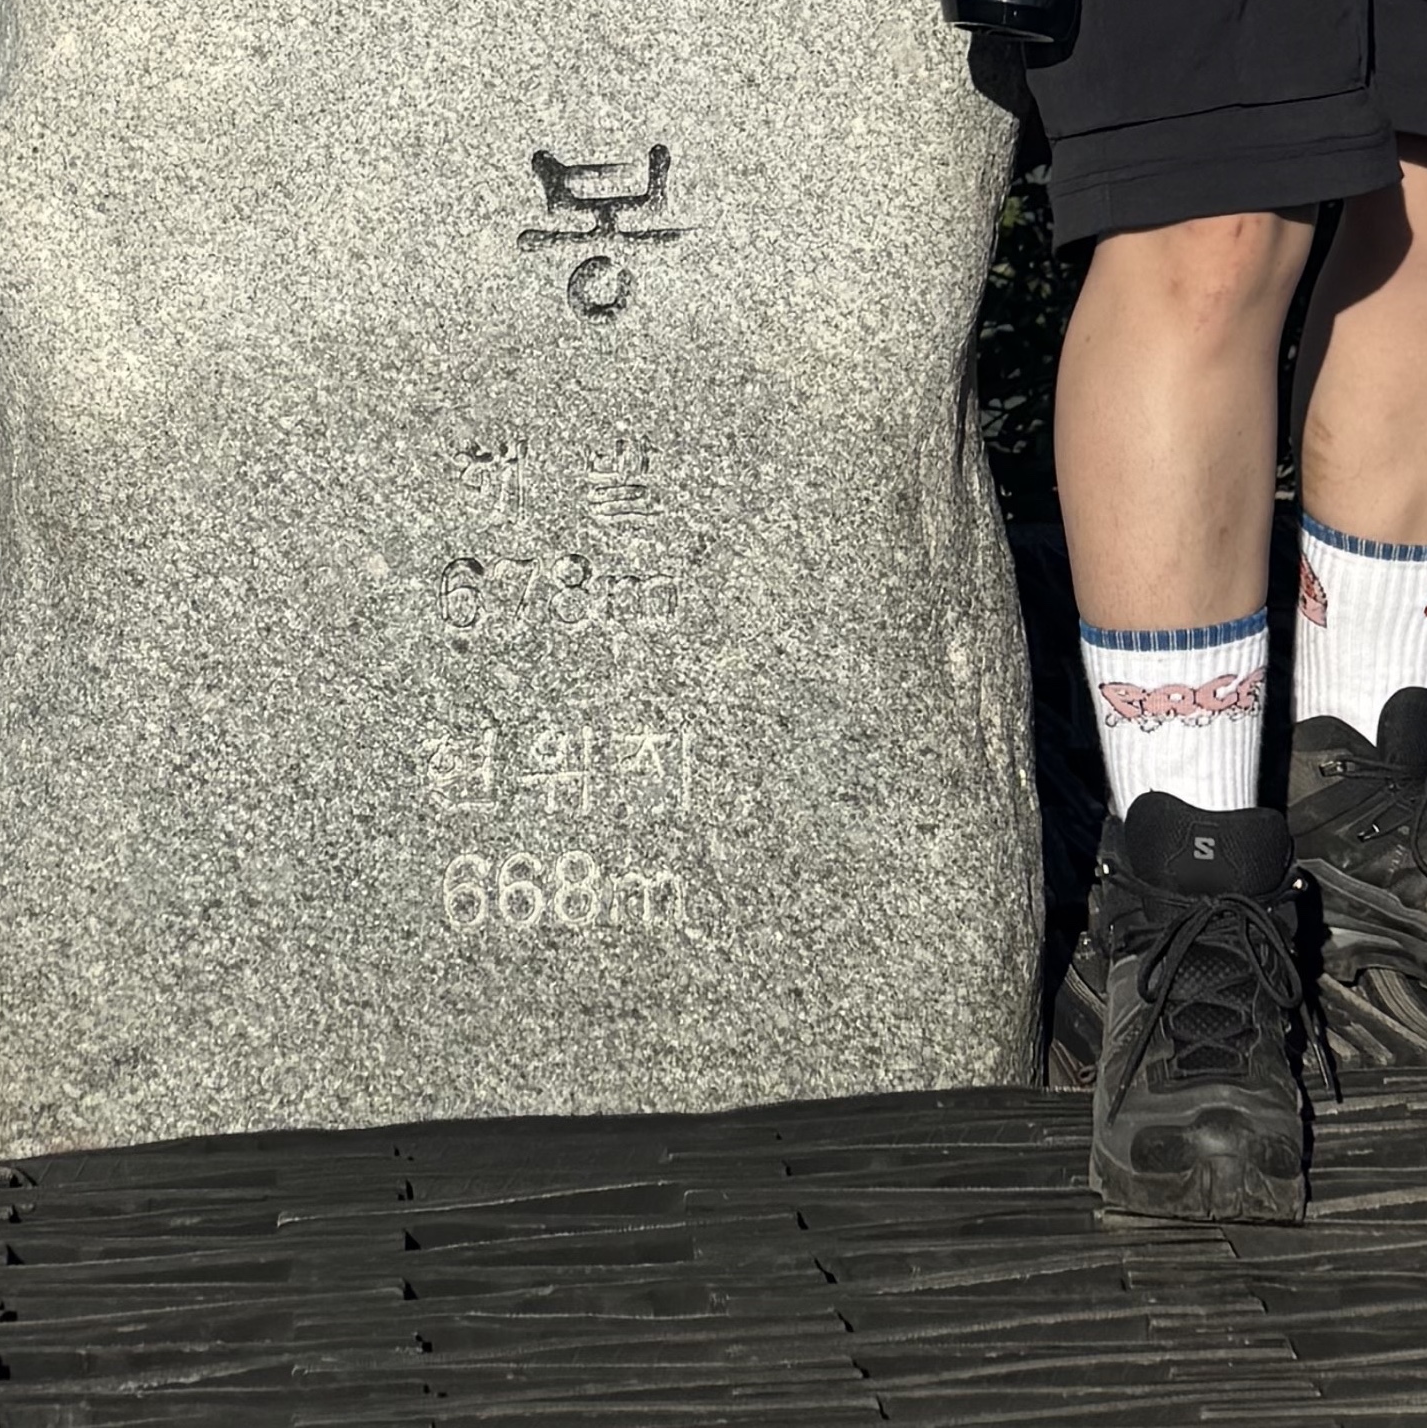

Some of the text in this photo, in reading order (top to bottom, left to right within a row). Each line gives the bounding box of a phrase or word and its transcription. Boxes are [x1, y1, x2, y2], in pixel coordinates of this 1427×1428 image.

[440, 553, 679, 629] 678m
[1193, 837, 1215, 860] S
[443, 850, 686, 929] 668m
